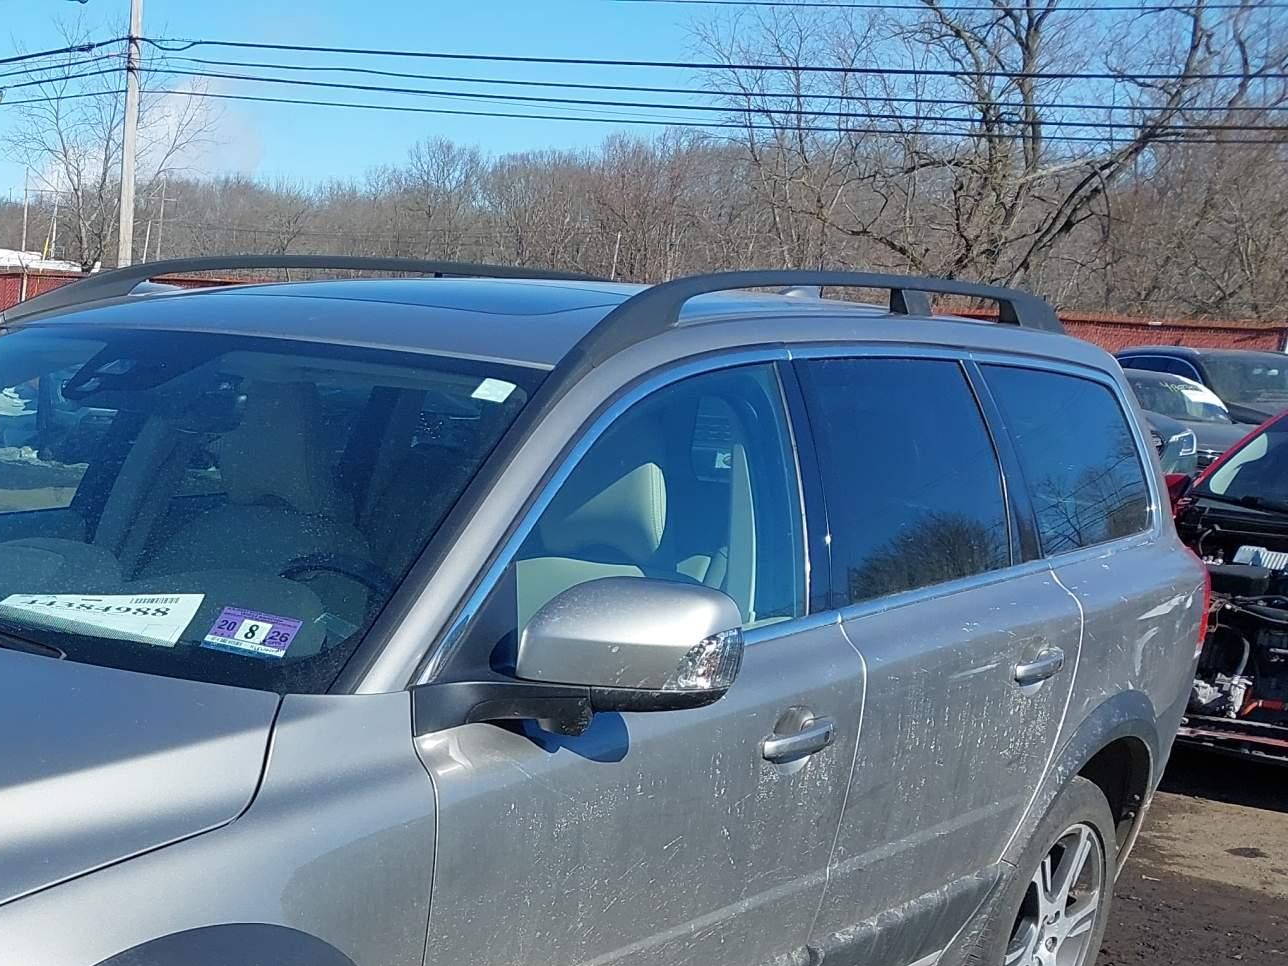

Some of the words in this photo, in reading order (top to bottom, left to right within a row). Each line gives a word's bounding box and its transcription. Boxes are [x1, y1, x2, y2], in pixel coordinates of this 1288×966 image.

[217, 619, 237, 631] 20
[244, 624, 259, 639] 8
[268, 630, 291, 643] 26
